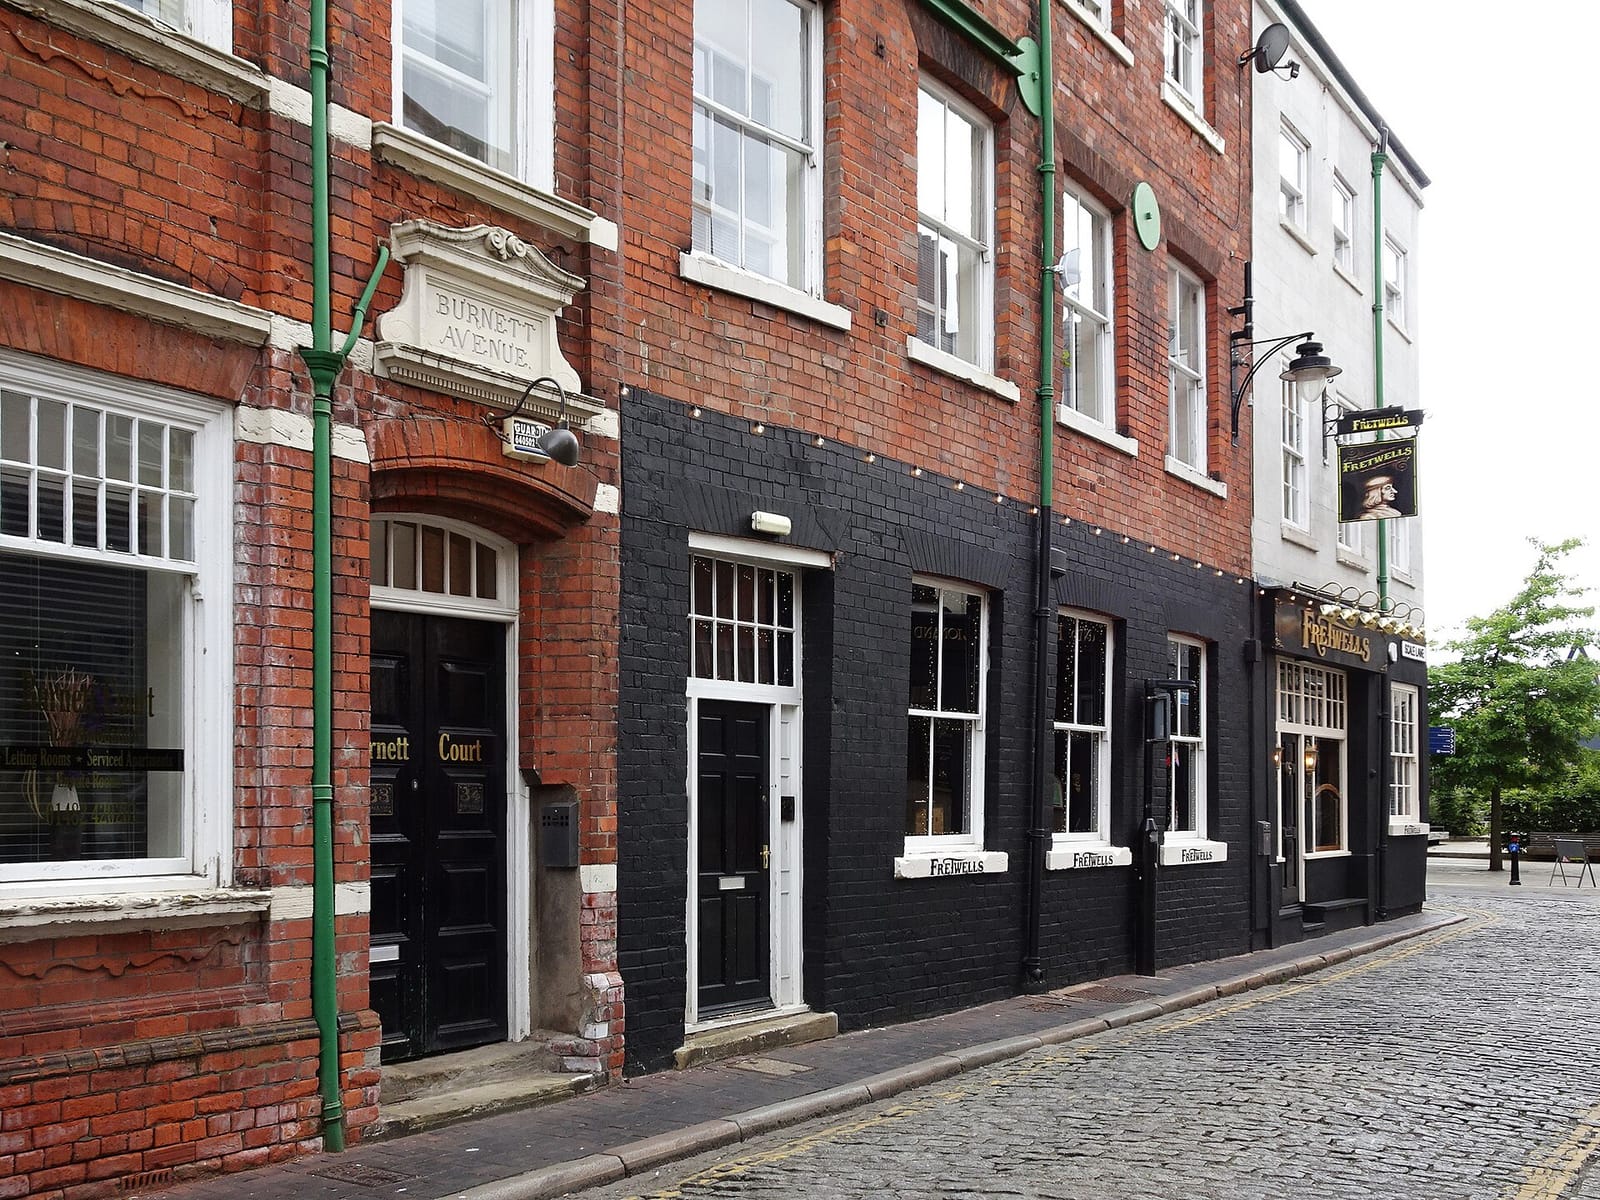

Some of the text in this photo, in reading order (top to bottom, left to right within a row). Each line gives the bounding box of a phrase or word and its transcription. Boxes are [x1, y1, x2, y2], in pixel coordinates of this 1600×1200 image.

[435, 291, 536, 343] BURNETT
[1352, 415, 1409, 431] FRETWELLS
[1342, 446, 1413, 473] FRETWELLS
[1302, 607, 1371, 663] FRETWELLS
[5, 747, 38, 769] Letting
[40, 748, 72, 767] Rooms
[87, 749, 124, 767] Serviced
[369, 732, 482, 762] rnett Court
[930, 857, 984, 875] FRETWELLS
[1073, 852, 1114, 867] FRETWELLS
[1182, 848, 1213, 862] FRETWELLS
